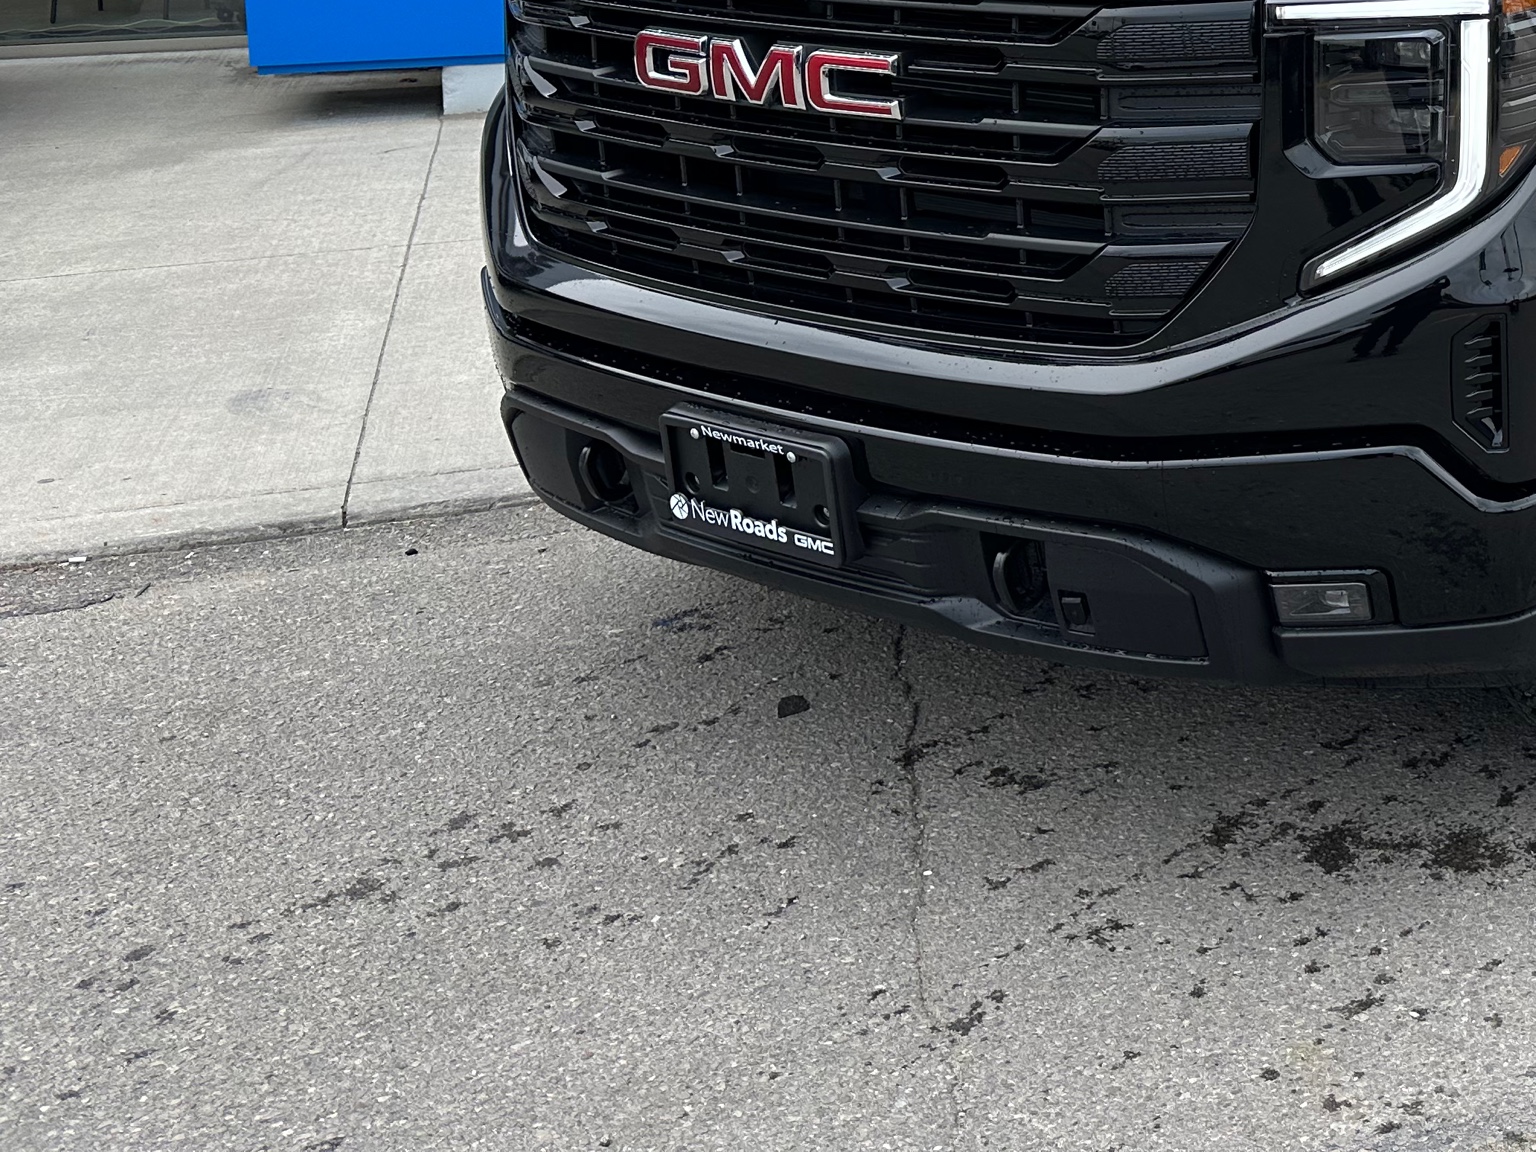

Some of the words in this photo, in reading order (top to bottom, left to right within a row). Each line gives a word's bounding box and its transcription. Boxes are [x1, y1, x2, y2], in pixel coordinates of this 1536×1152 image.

[633, 26, 901, 120] GMC
[700, 425, 785, 456] Newmarket
[690, 497, 788, 544] NewRoads
[794, 533, 835, 556] GMC
